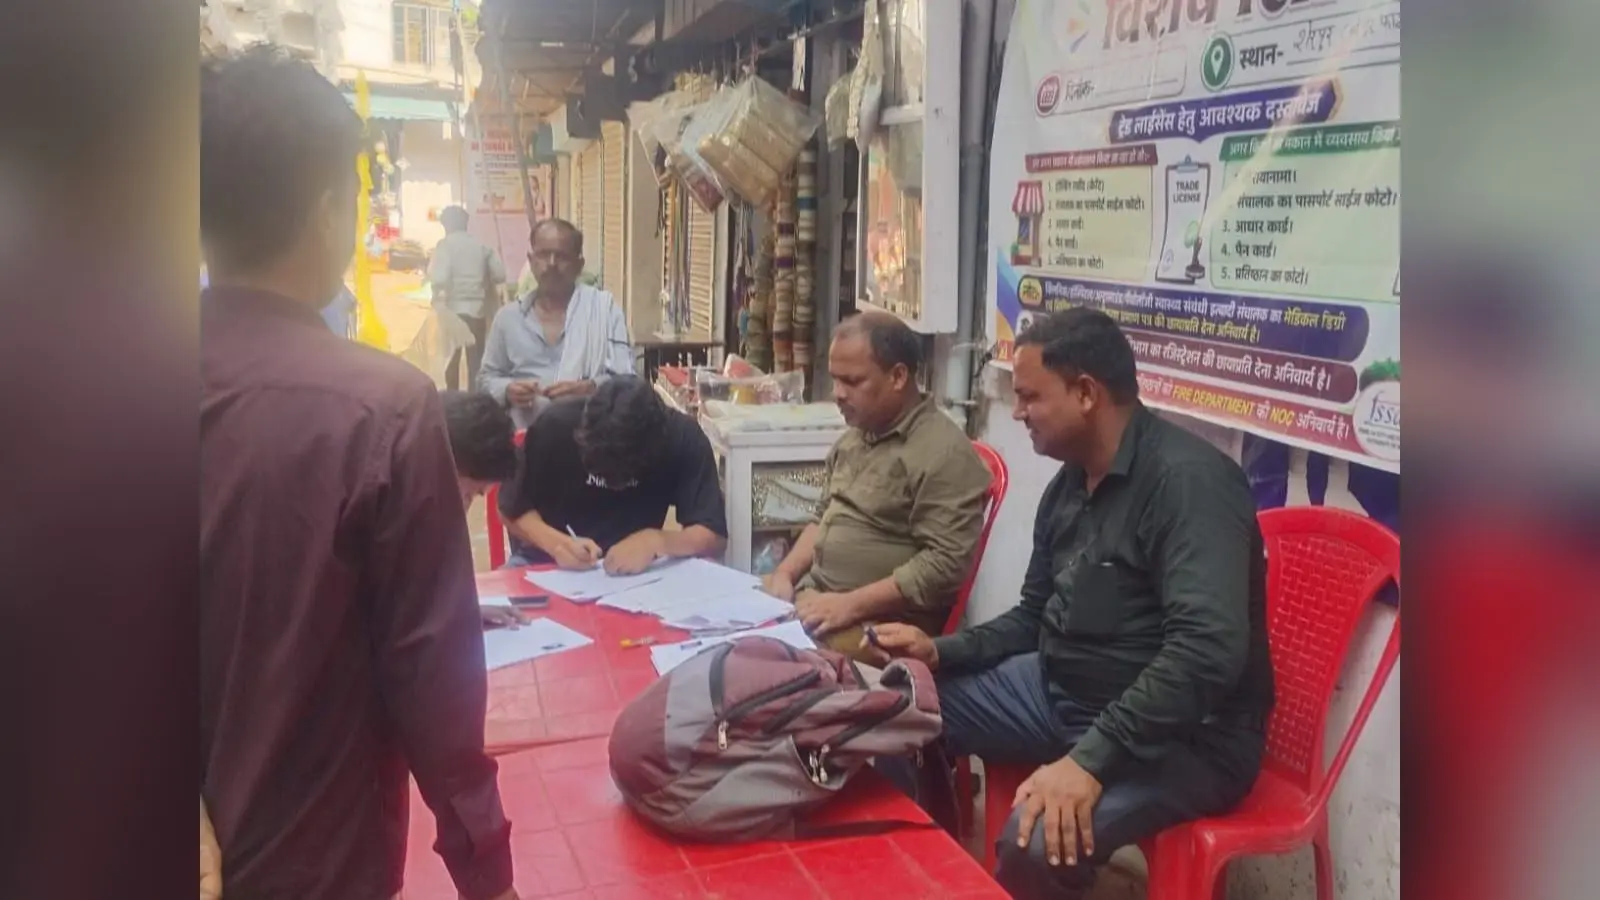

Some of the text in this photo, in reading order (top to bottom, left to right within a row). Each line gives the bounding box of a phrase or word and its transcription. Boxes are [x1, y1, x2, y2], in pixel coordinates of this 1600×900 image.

[1239, 44, 1284, 69] स्थान-
[1118, 89, 1323, 139] ट्रेड लाईसेंस हेतु आवश्यक दस्तावेज
[1314, 129, 1324, 148] में
[1326, 131, 1369, 148] व्यवसाय
[1371, 124, 1396, 144] किया
[1176, 181, 1199, 191] TRADE
[1237, 192, 1274, 209] संचालक
[1277, 194, 1293, 209] का
[1295, 189, 1334, 209] पासपोर्ट
[1364, 185, 1397, 208] फोटो।
[1173, 193, 1201, 204] LICENSE
[1222, 216, 1294, 234] 3. आधार कार्ड।
[1220, 240, 1277, 259] 4. पैन कार्ड।
[1221, 264, 1309, 286] 5. प्रतिष्ठान का फोटो।
[1141, 313, 1153, 327] पत्र
[1153, 310, 1166, 328] की
[1200, 321, 1215, 336] देना
[1216, 321, 1250, 342] अनिवार्य
[1250, 327, 1261, 343] है।
[1183, 298, 1208, 315] संबंधी
[1236, 303, 1267, 323] संचालक
[1269, 310, 1283, 324] का
[1284, 307, 1320, 328] मेडिकल
[1321, 310, 1347, 332] डिग्री
[1149, 343, 1161, 357] का
[1202, 348, 1216, 368] की
[1216, 354, 1253, 376] छायाप्रति
[1254, 357, 1272, 380] देना
[1273, 362, 1316, 387] अनिवार्य
[1317, 367, 1331, 391] है।
[1172, 385, 1194, 401] FIRE
[1193, 389, 1256, 417] DEPARTMENT
[1269, 406, 1296, 427] NOC
[1296, 409, 1337, 436] अनिवार्य
[1336, 418, 1350, 441] है।
